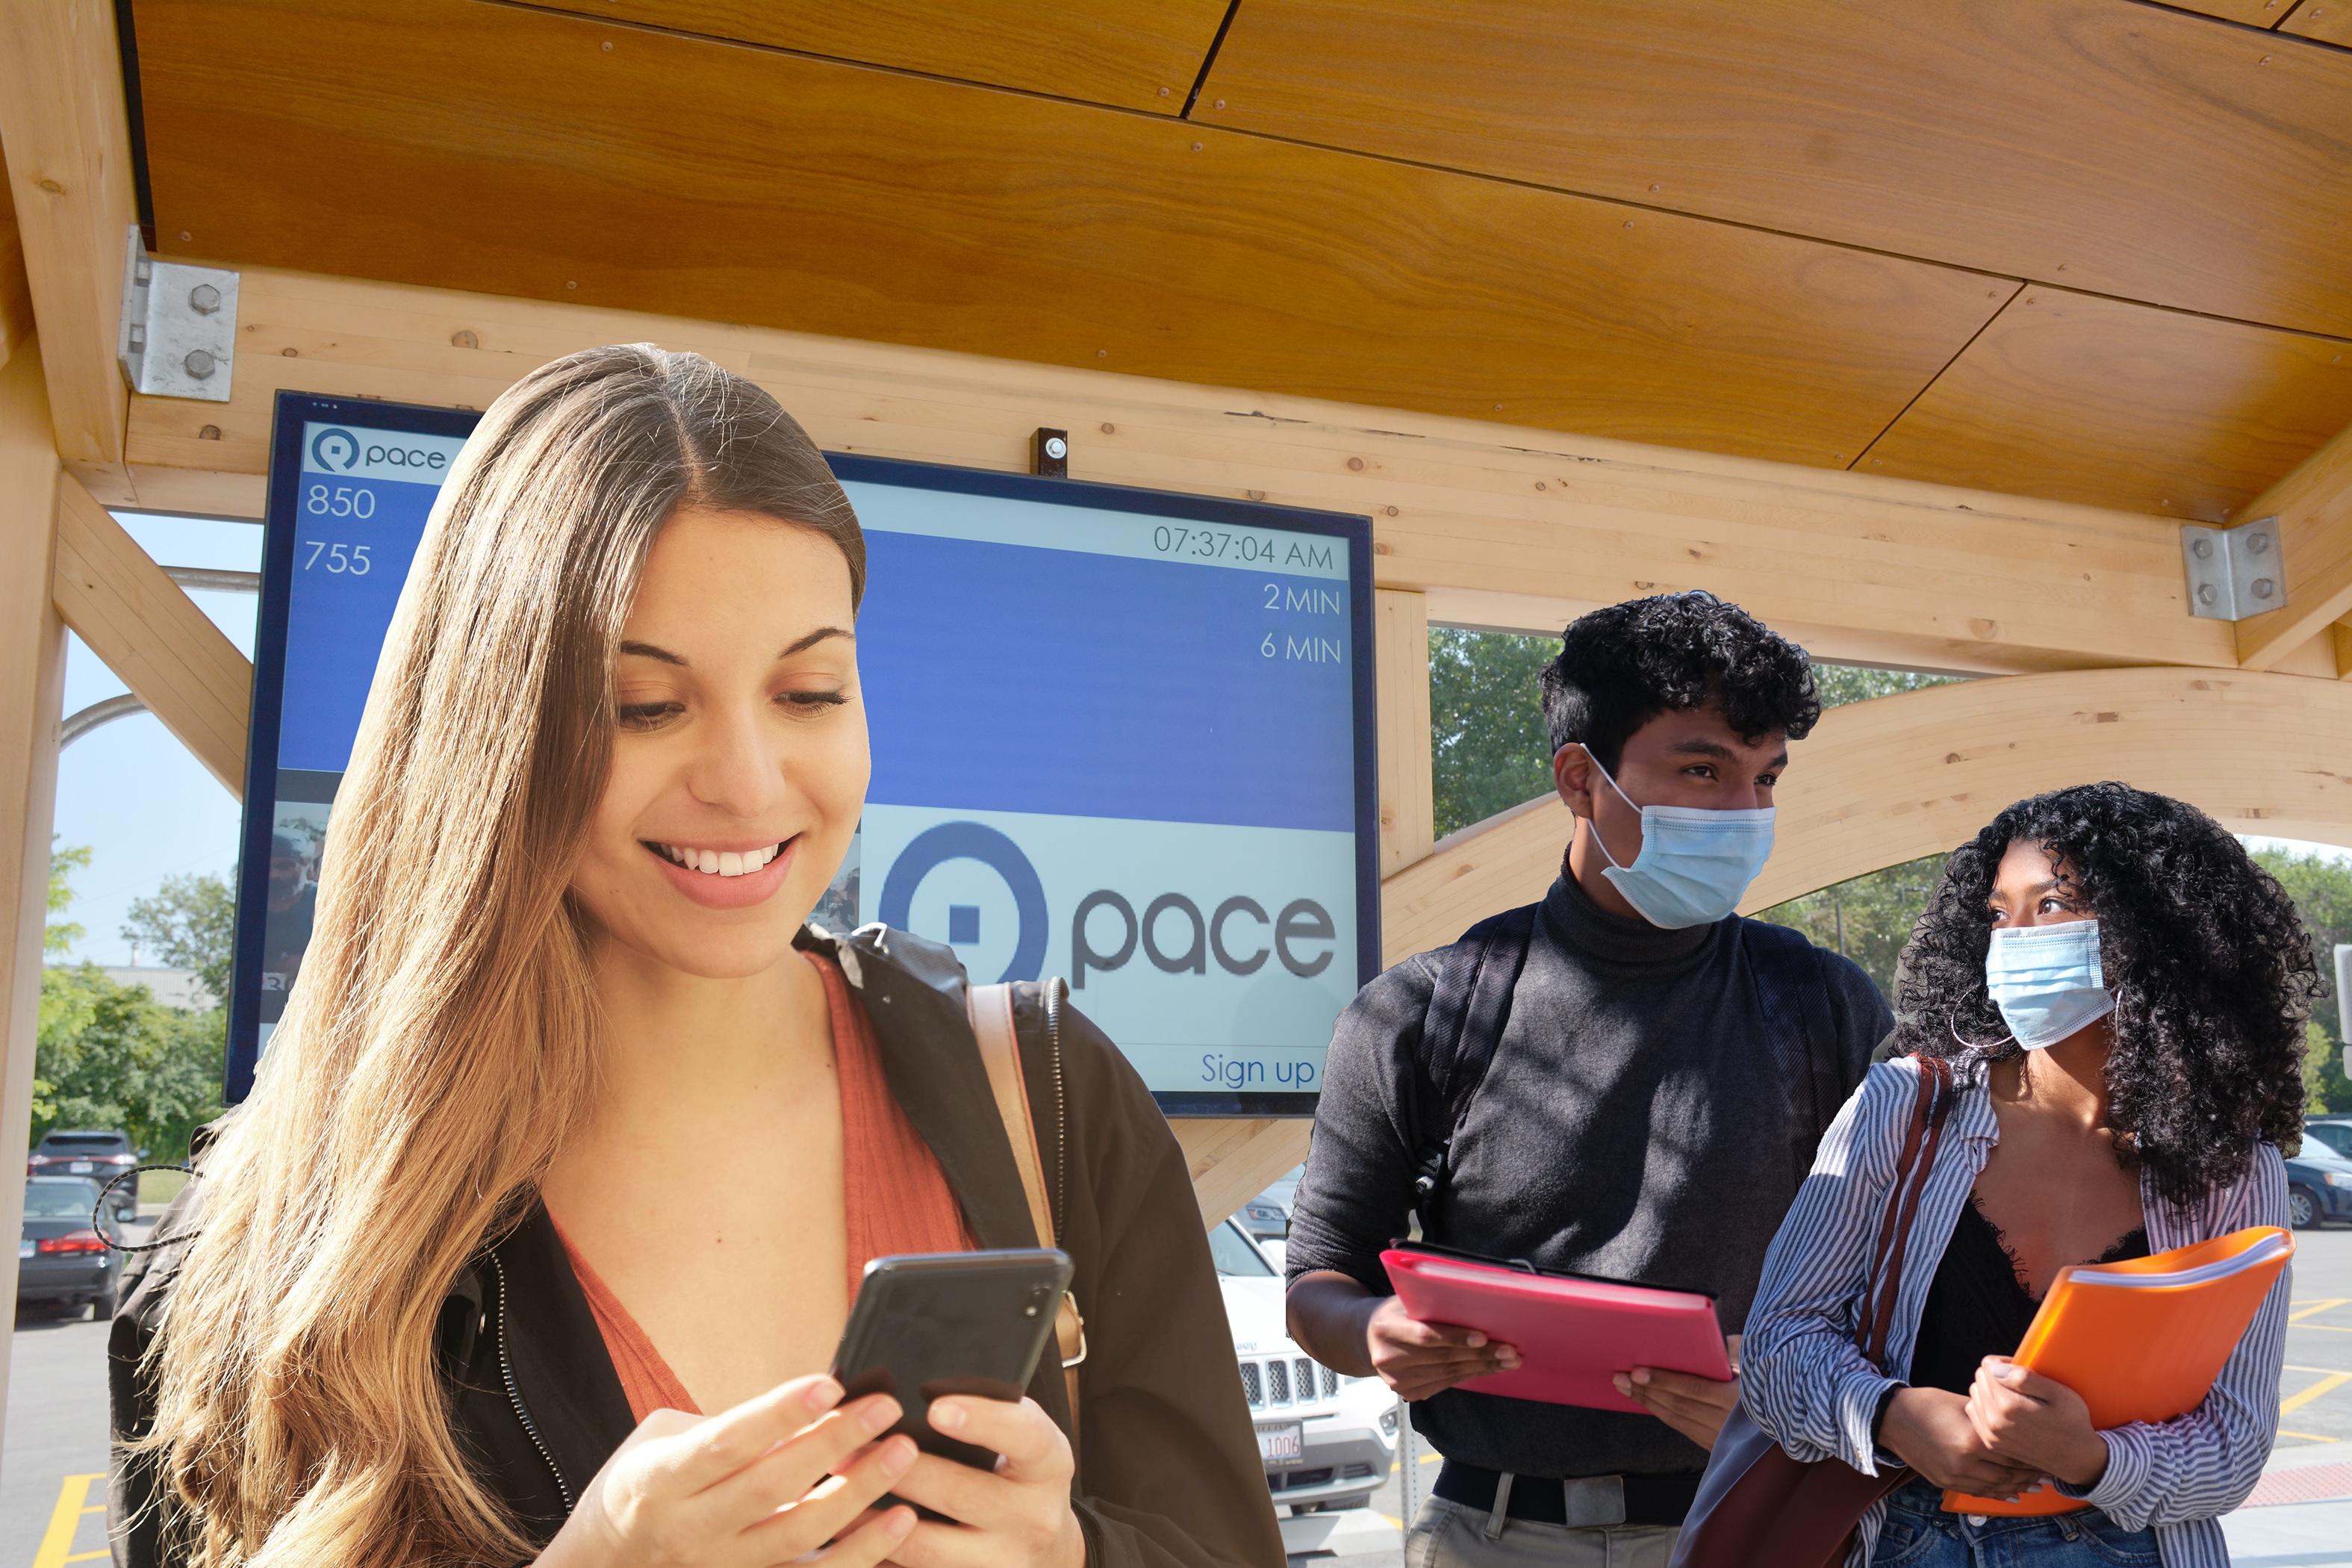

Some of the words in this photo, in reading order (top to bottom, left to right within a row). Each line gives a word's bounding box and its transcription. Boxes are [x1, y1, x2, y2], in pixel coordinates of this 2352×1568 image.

[366, 445, 446, 469] pace
[308, 485, 376, 519] 850
[305, 541, 371, 575] 755
[1154, 526, 1275, 563] 07:37:04
[1285, 542, 1333, 570] AM
[1263, 583, 1280, 610] 2
[1286, 586, 1340, 615] MIN
[1260, 632, 1276, 658] 6
[1287, 635, 1341, 664] MIN
[1072, 889, 1336, 989] pace
[1201, 1053, 1265, 1089] Sign
[1277, 1057, 1314, 1089] up
